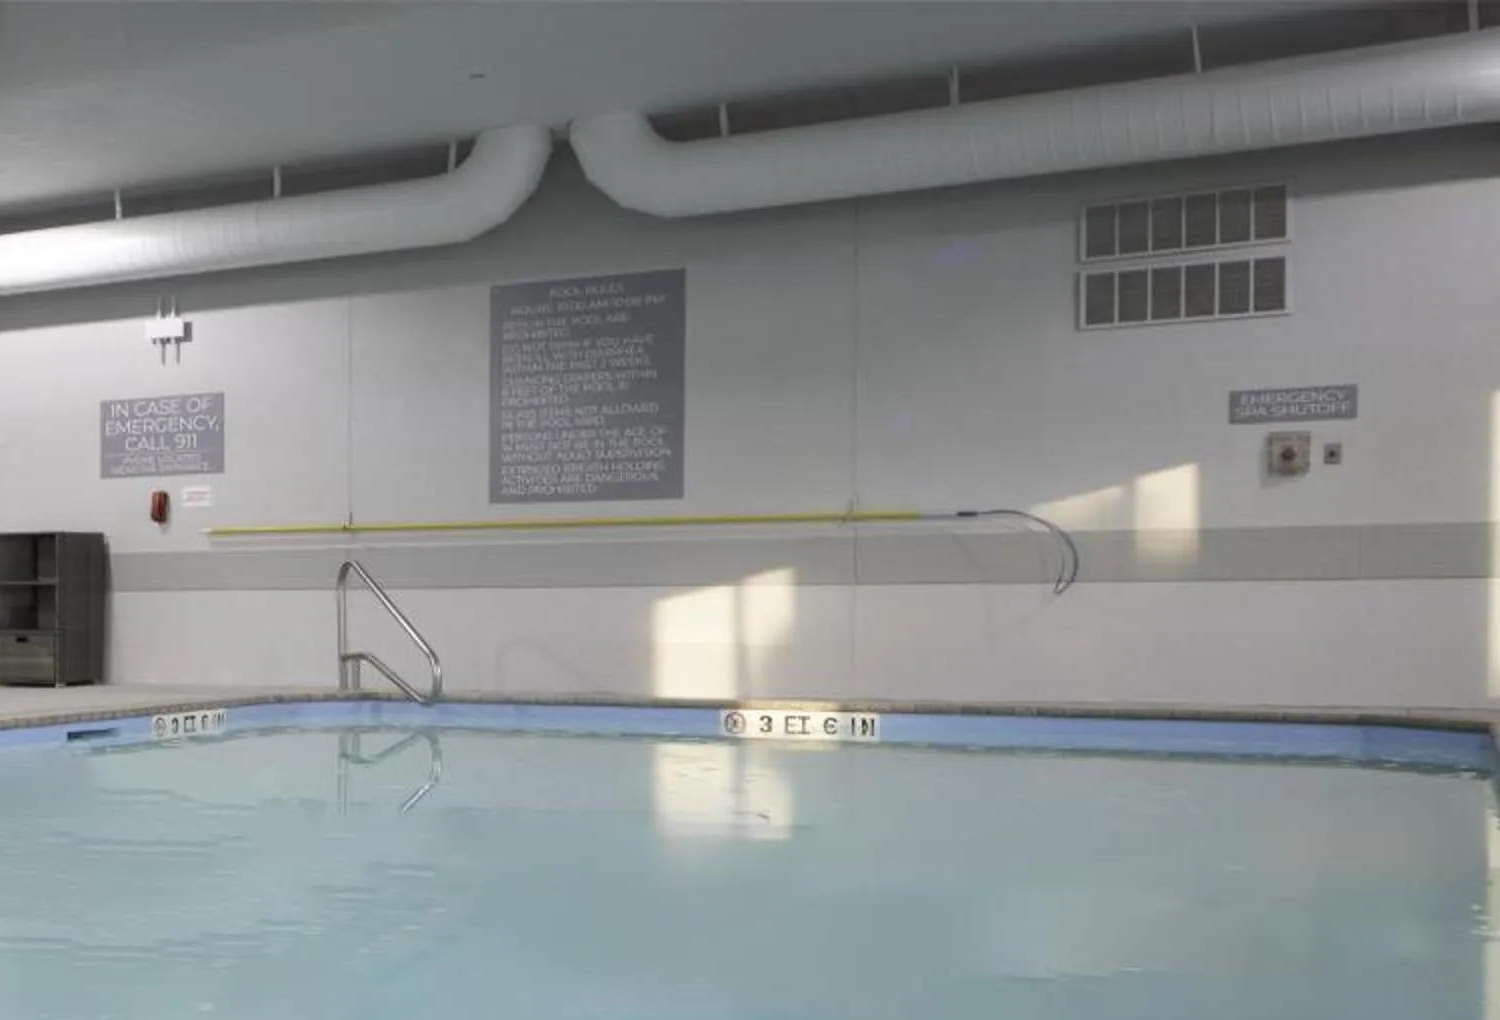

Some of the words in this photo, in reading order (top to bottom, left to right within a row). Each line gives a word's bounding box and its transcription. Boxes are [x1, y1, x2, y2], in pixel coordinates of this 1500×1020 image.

[110, 402, 130, 418] IN
[133, 400, 181, 418] CASE
[186, 397, 214, 413] OF
[105, 415, 220, 437] EMERGENCY,
[125, 435, 171, 451] CALL
[173, 433, 197, 449] 911
